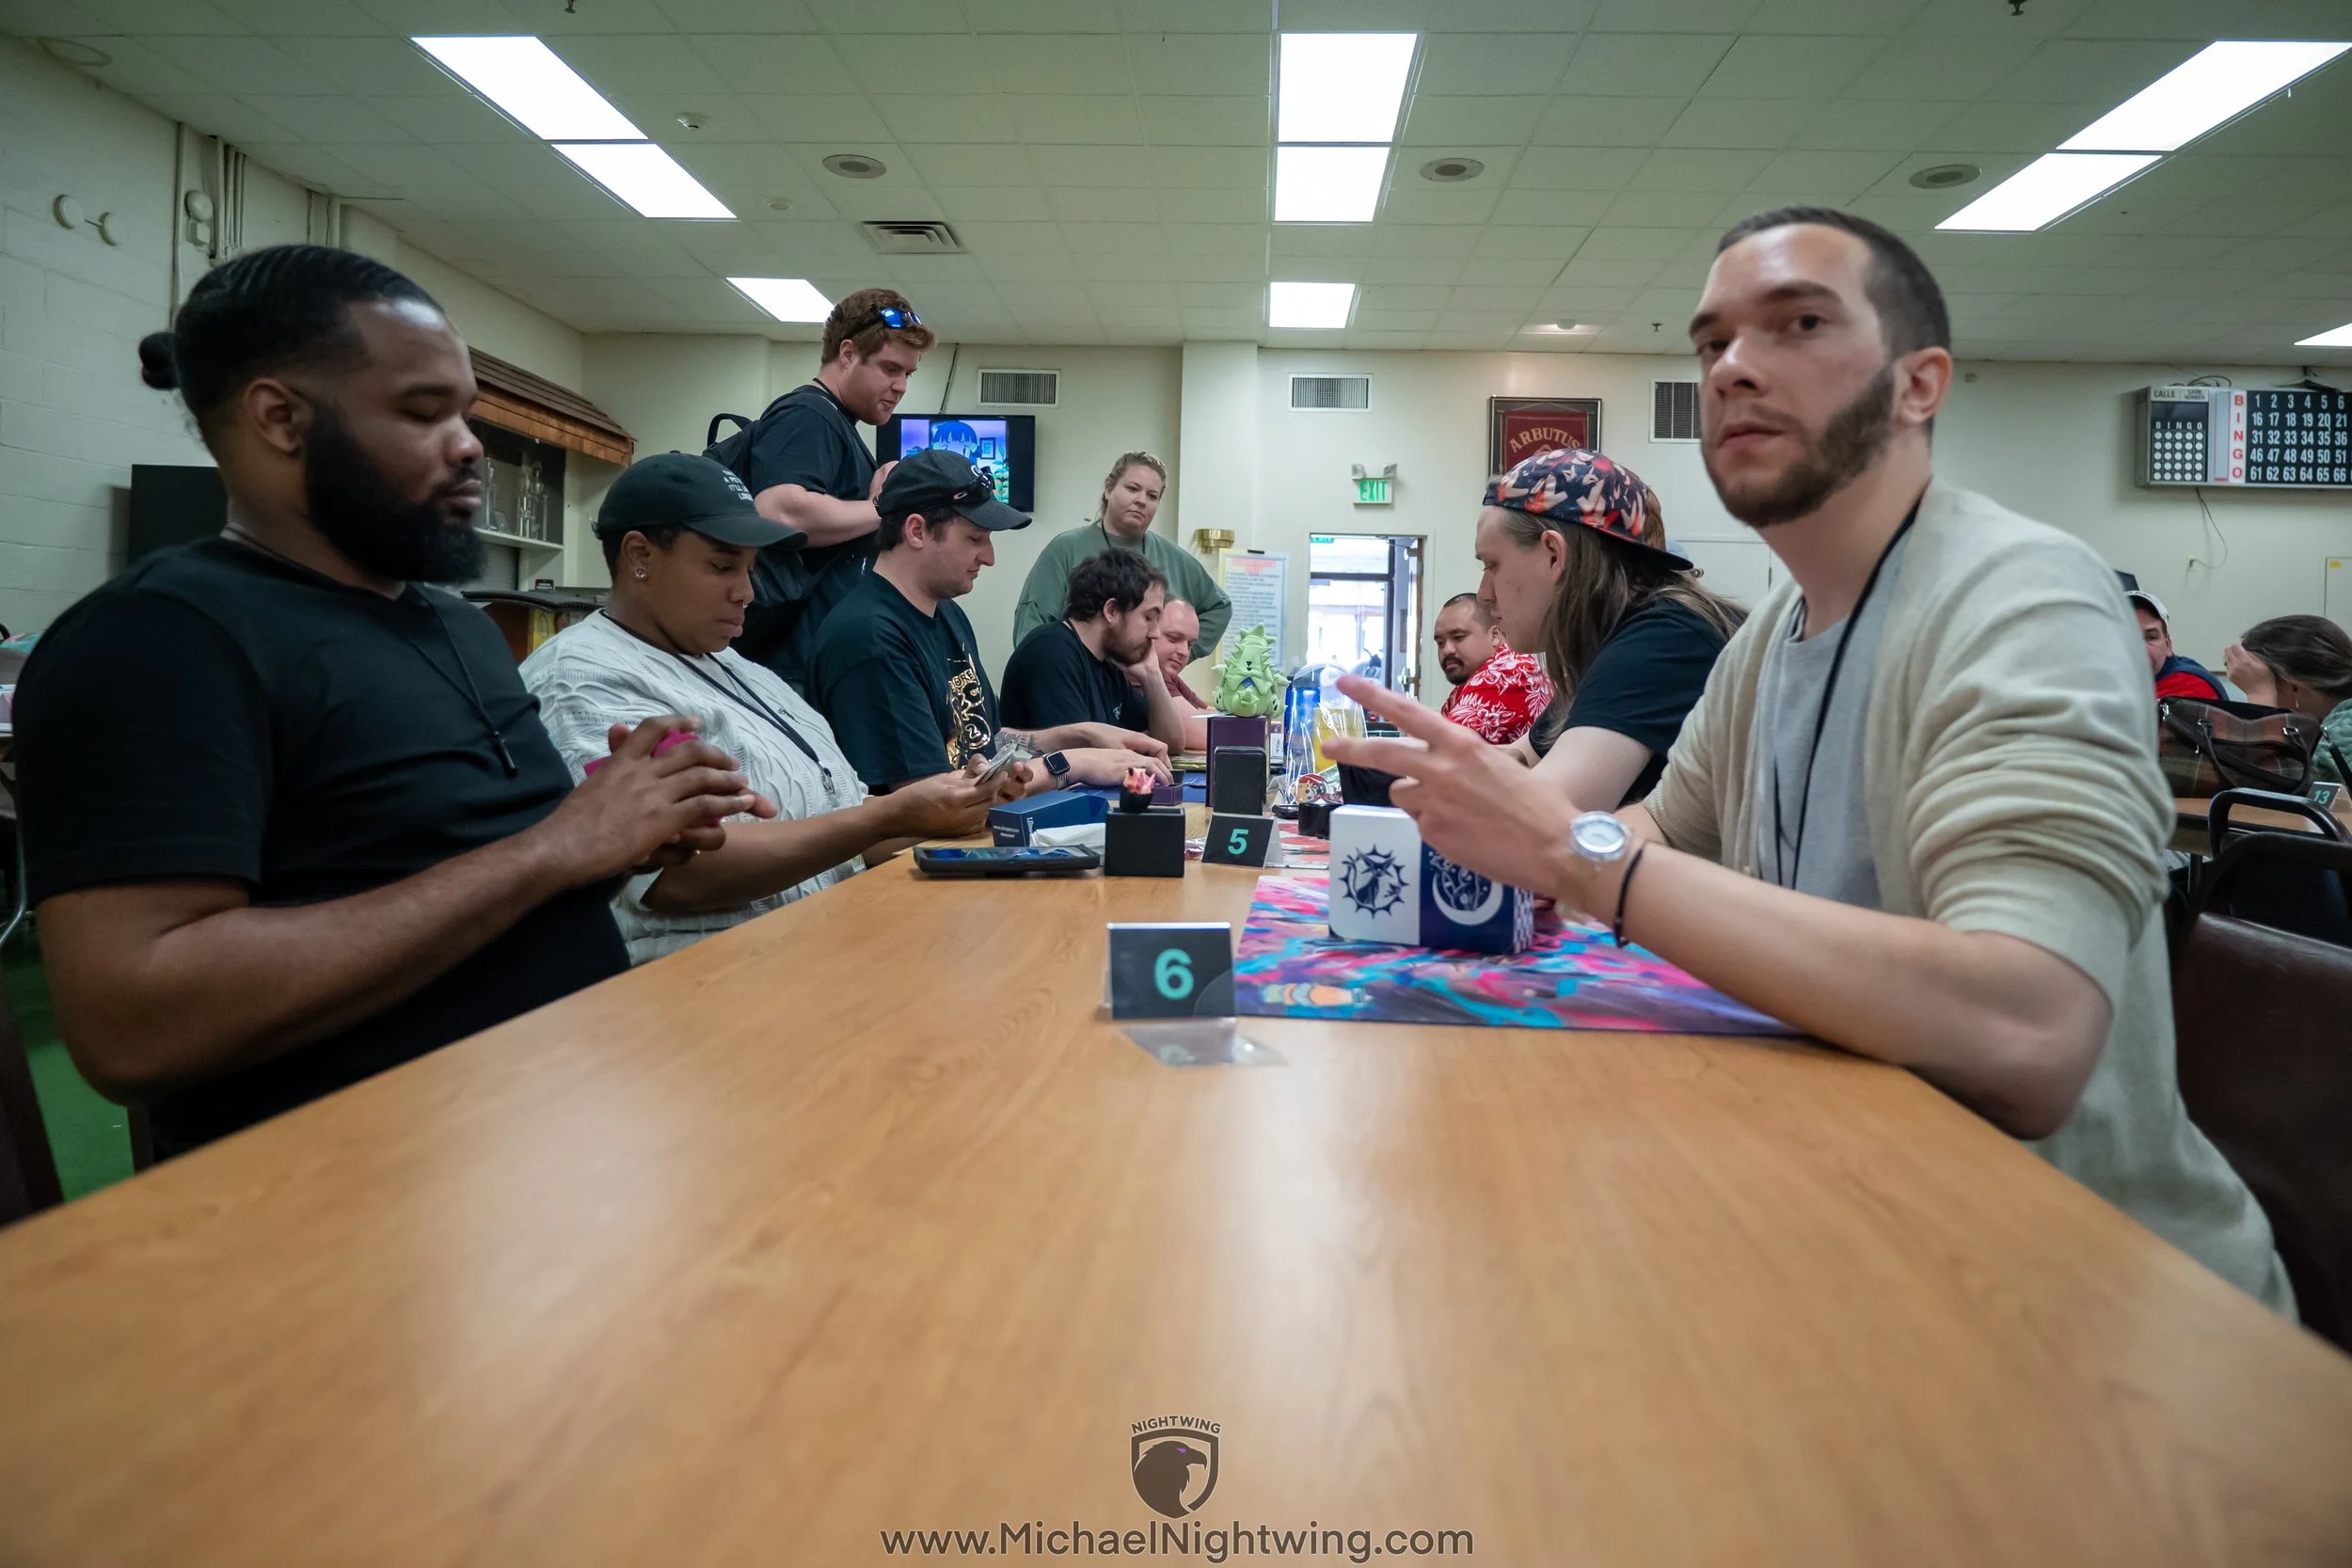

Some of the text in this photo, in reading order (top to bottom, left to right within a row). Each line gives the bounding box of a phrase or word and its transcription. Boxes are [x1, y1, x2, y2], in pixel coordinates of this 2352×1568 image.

[2153, 389, 2175, 399] CALLS
[2255, 394, 2345, 410] 1 2 3 4 5 6
[2251, 412, 2347, 427] 16 17 18 19 20 21
[1509, 427, 1581, 453] ARBUTUS
[2251, 430, 2348, 446] 31 32 33 34 35 36
[2249, 448, 2346, 464] 46 47 48 49 50 51
[2249, 467, 2346, 483] 61 62 63 64 65 66
[1359, 481, 1388, 501] EXIT
[2314, 789, 2330, 804] 13
[1228, 828, 1249, 855] 5
[1153, 948, 1195, 1000] 6
